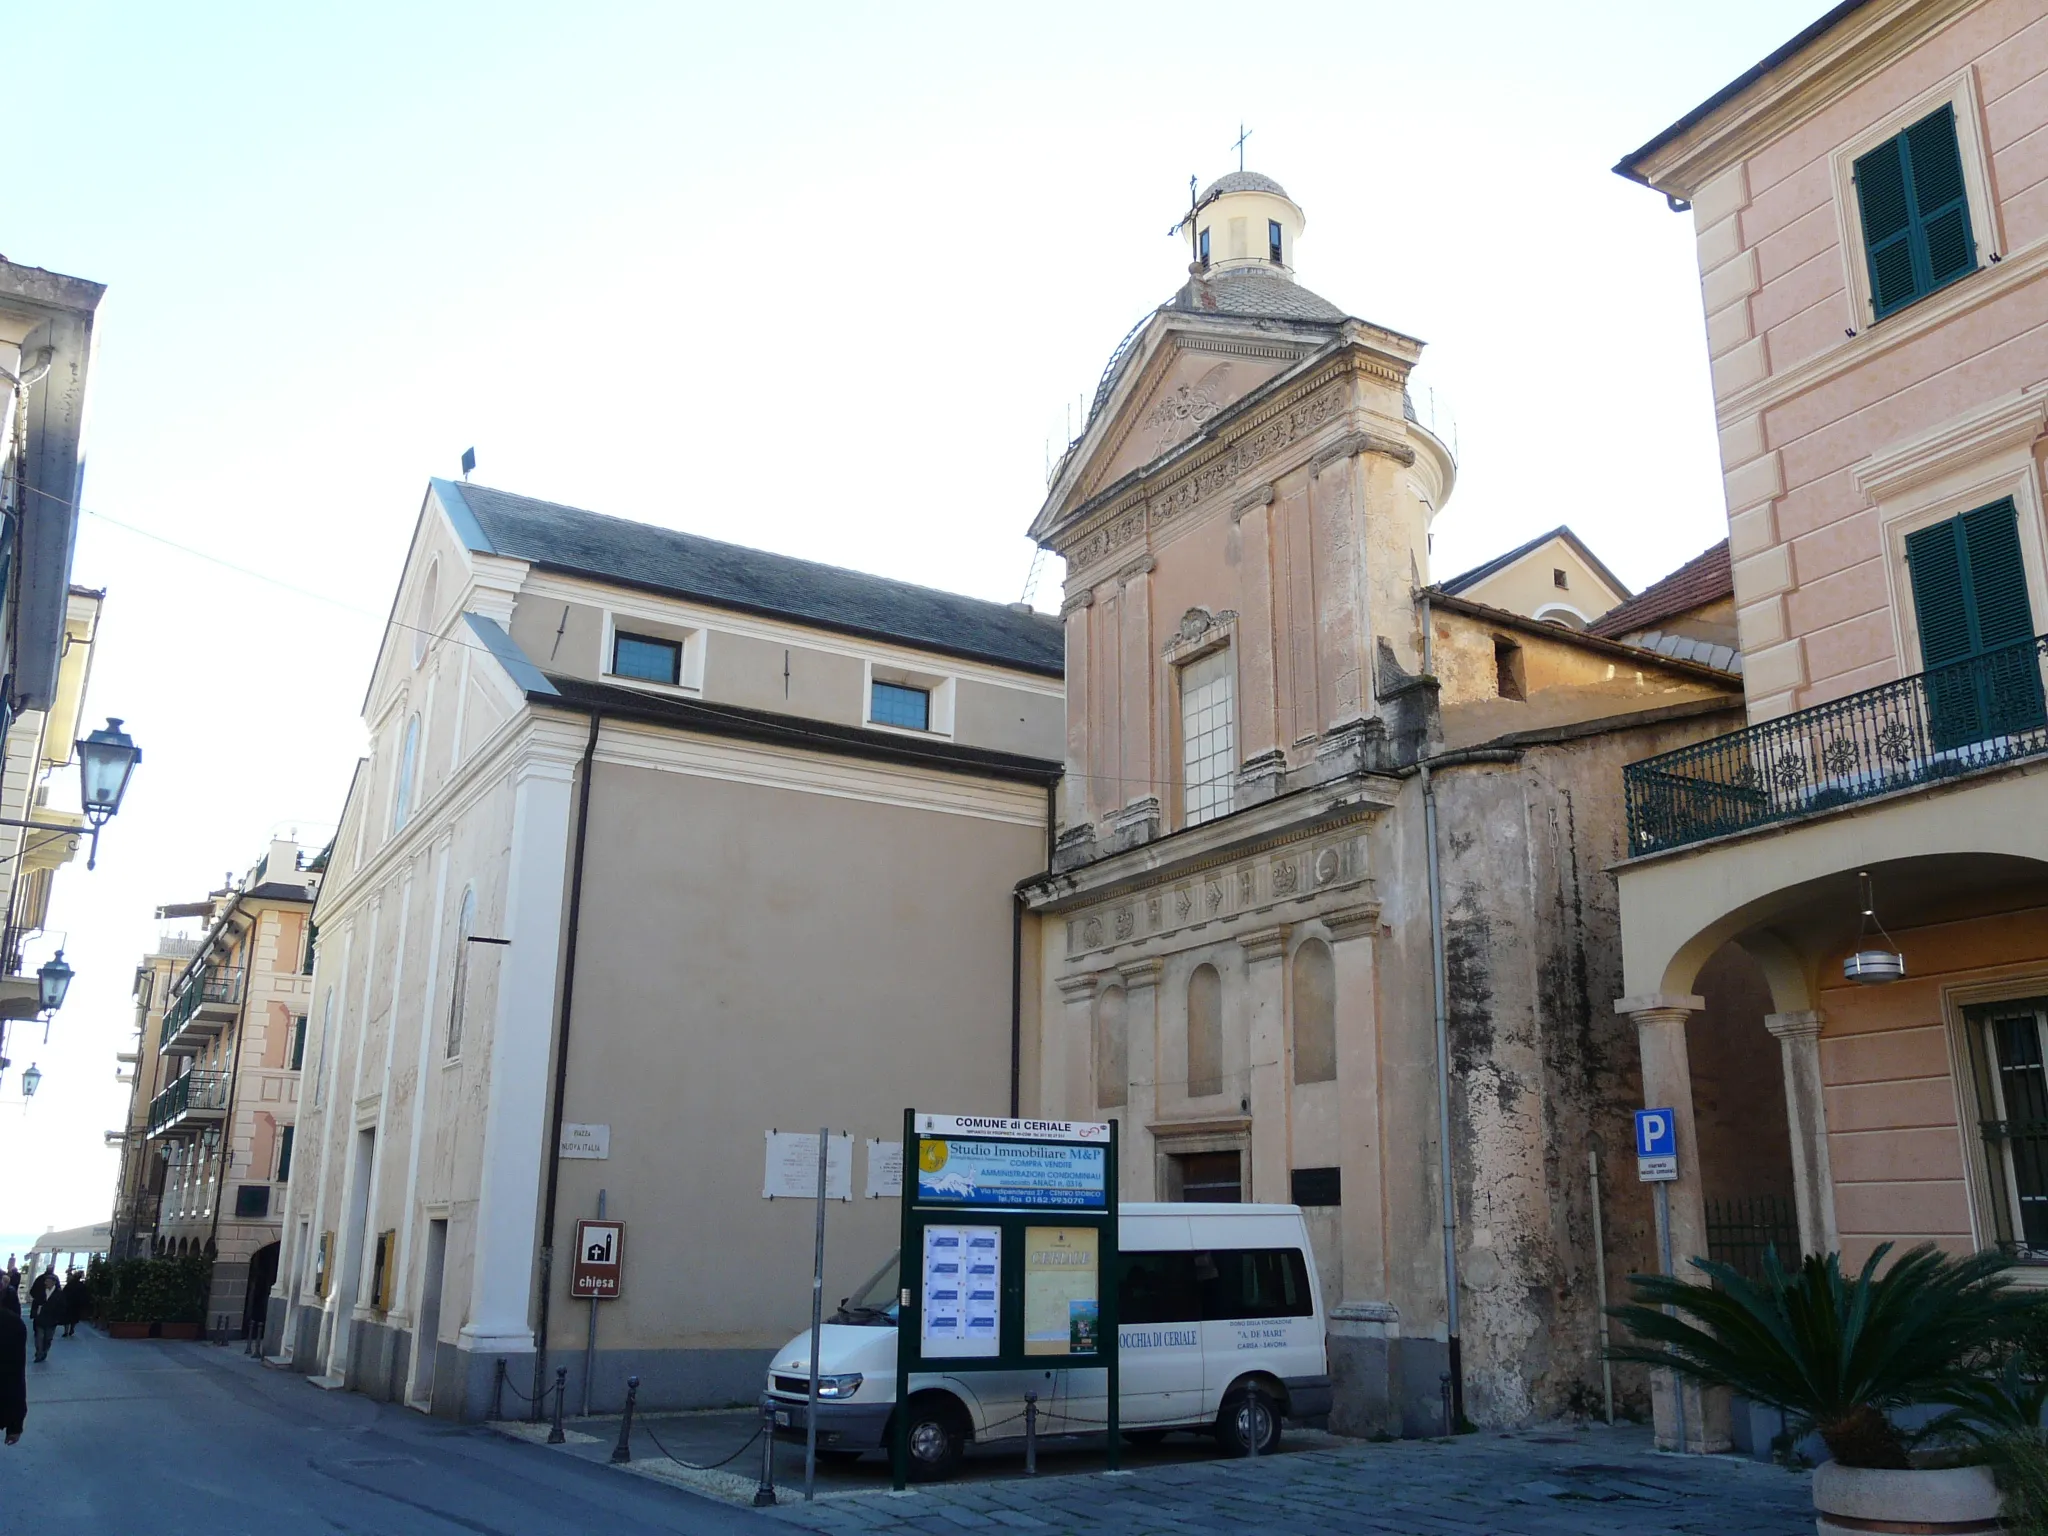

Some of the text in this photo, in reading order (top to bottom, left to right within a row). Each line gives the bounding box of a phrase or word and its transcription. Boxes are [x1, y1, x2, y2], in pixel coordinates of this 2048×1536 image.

[955, 1117, 1008, 1129] COMUNE
[1010, 1120, 1021, 1130] di
[1023, 1121, 1072, 1132] CERIALE
[1642, 1114, 1666, 1152] P
[561, 1143, 601, 1151] NUOVA ITALIA
[950, 1142, 991, 1156] Studio
[994, 1145, 1067, 1160] Immobiliare
[1069, 1149, 1101, 1160] M&P
[1009, 1159, 1073, 1169] COMPRA VENDITE
[980, 1168, 1101, 1180] AMMINISTRAZIONI CONDOMINIALI
[1032, 1179, 1057, 1187] ANACI
[992, 1188, 1036, 1196] Indipendenza
[1049, 1189, 1074, 1197] CENTRO
[1074, 1190, 1101, 1198] STORICO
[1025, 1196, 1085, 1205] 0182.993070
[1031, 1251, 1092, 1265] CERIALE
[579, 1275, 614, 1288] chiesa
[1153, 1331, 1162, 1347] DI
[1164, 1330, 1197, 1347] CERIALE
[1250, 1330, 1261, 1339] DE
[1263, 1341, 1288, 1349] SAVONA
